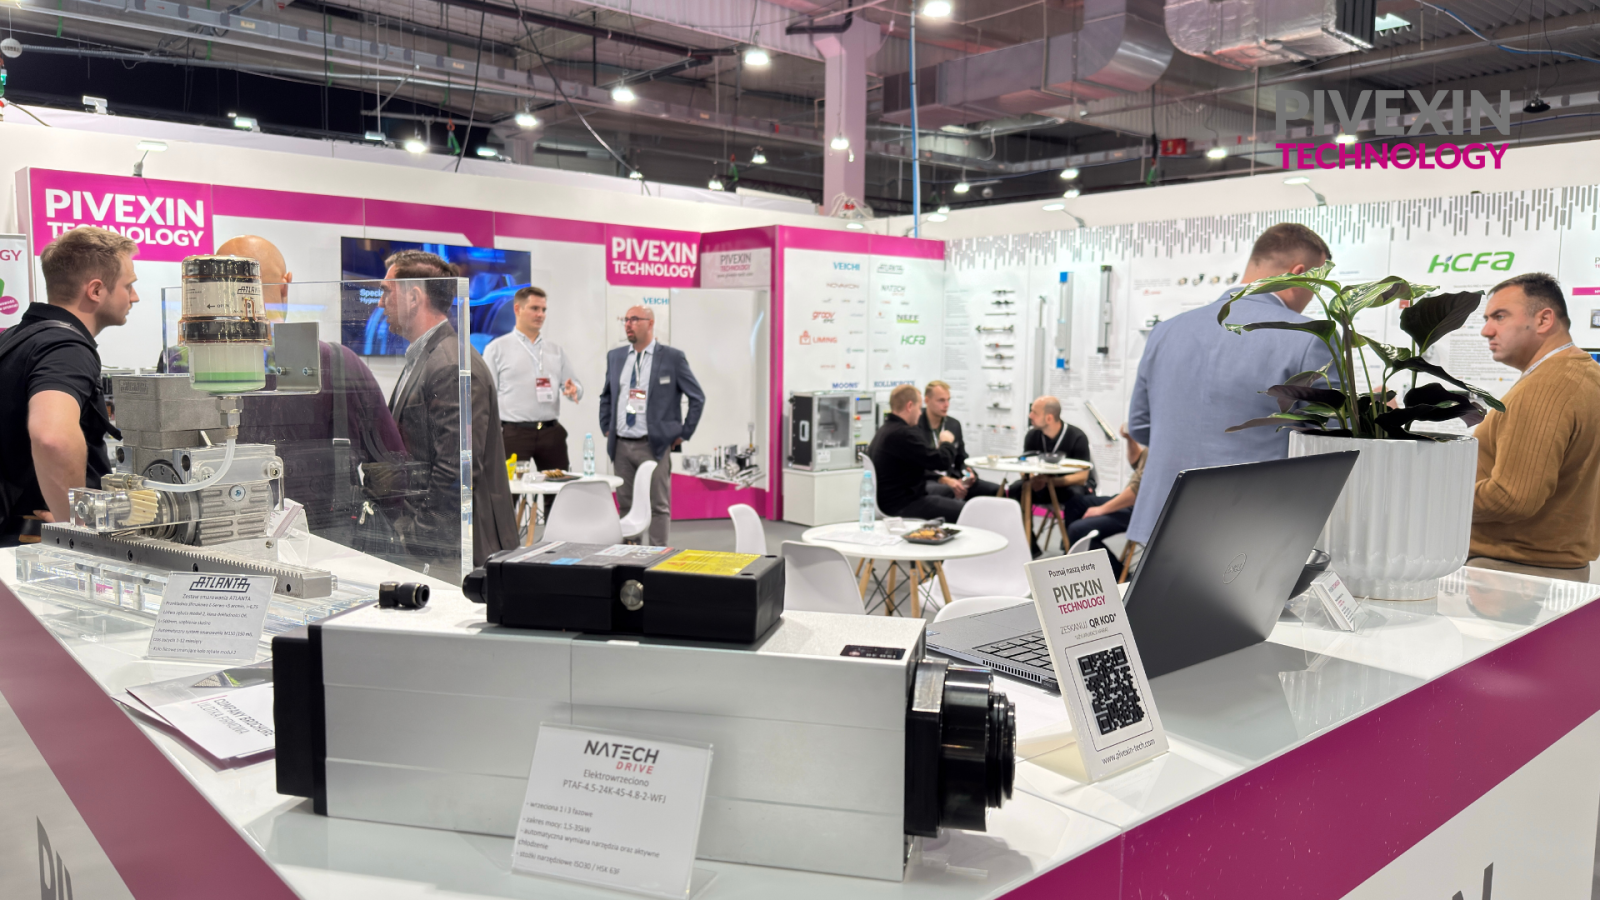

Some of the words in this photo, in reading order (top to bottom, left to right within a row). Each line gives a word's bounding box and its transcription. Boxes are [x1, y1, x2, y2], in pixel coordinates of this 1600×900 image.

[46, 188, 204, 228] PIVEXIN
[612, 236, 697, 264] PIVEXIN
[612, 260, 697, 278] TECHNOLOGY
[833, 262, 860, 270] VEICHI
[1048, 568, 1066, 577] Poznaj
[1066, 566, 1080, 574] naszą
[189, 576, 250, 593] ATLANTA
[1053, 578, 1103, 603] PIVEXIN
[1058, 595, 1105, 614] TECHNOLOGY
[1089, 618, 1100, 628] QR
[584, 740, 659, 764] NATECH
[616, 761, 654, 775] DRIVE
[583, 769, 649, 787] Elektrowrzeciono
[530, 802, 558, 812] wrzeciona
[572, 808, 593, 817] fazowe
[526, 816, 544, 826] zakres
[524, 829, 563, 840] automatyczna
[565, 836, 590, 846] wymiana
[620, 846, 633, 854] oraz
[634, 847, 660, 858] aktywne
[596, 864, 608, 873] HSK
